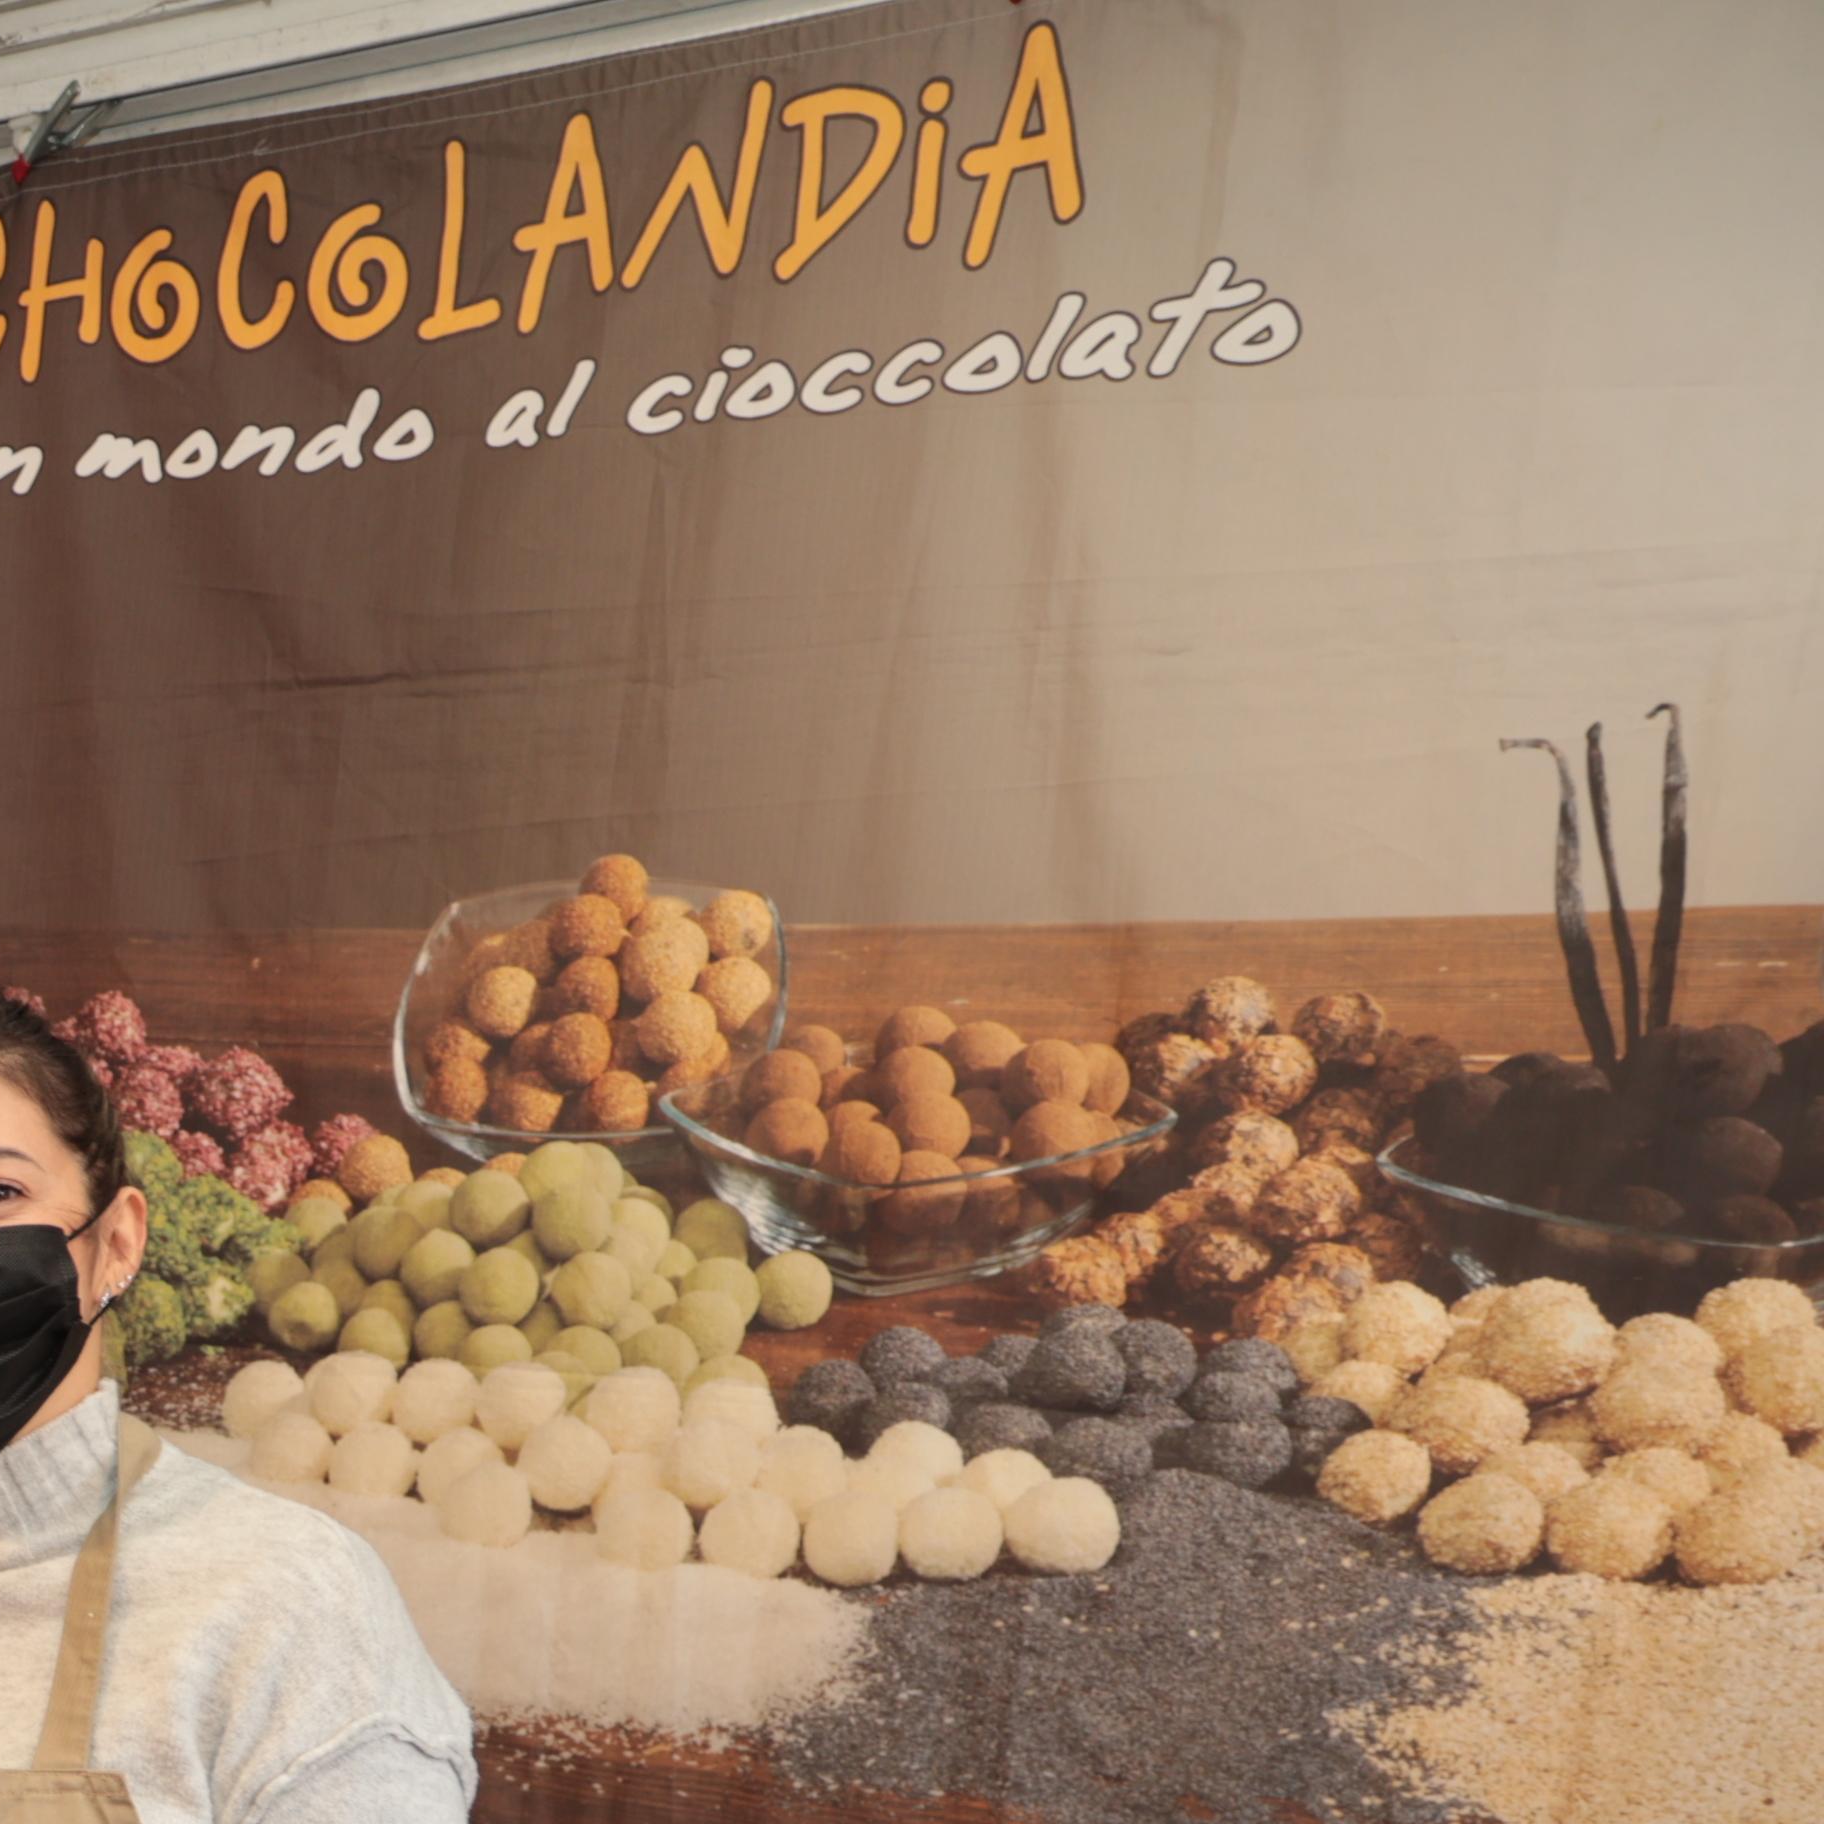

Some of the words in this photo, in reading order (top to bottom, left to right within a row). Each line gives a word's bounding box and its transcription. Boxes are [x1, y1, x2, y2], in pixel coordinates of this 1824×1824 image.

[75, 389, 434, 485] mondo
[485, 360, 595, 452] al
[627, 258, 1303, 436] cioccolato
